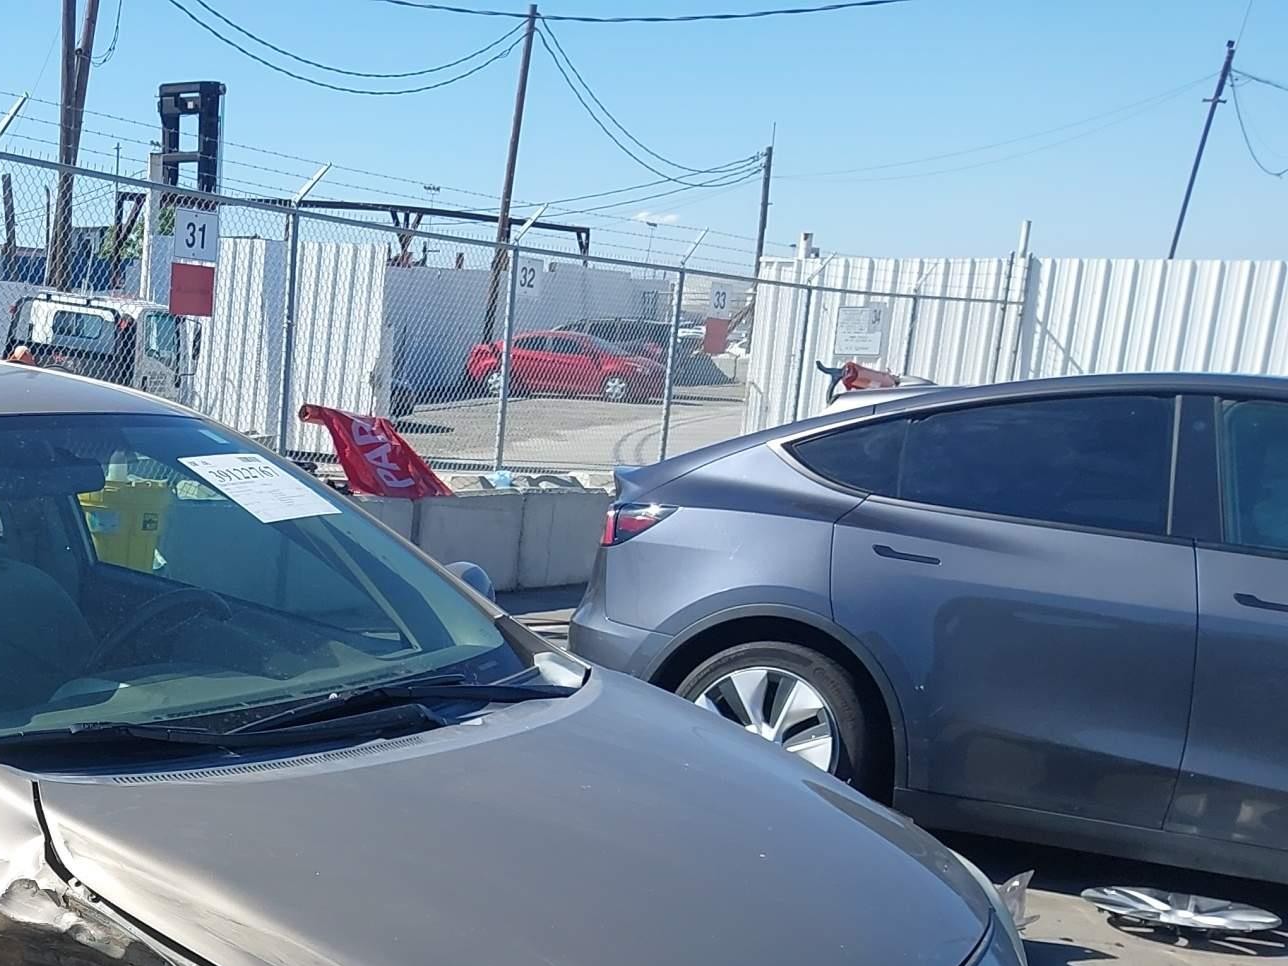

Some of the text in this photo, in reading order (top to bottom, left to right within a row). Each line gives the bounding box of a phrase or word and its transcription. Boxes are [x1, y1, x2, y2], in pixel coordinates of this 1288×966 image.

[184, 222, 207, 250] 31
[519, 266, 536, 289] 32
[713, 291, 727, 310] 33
[208, 465, 280, 483] 39122767
